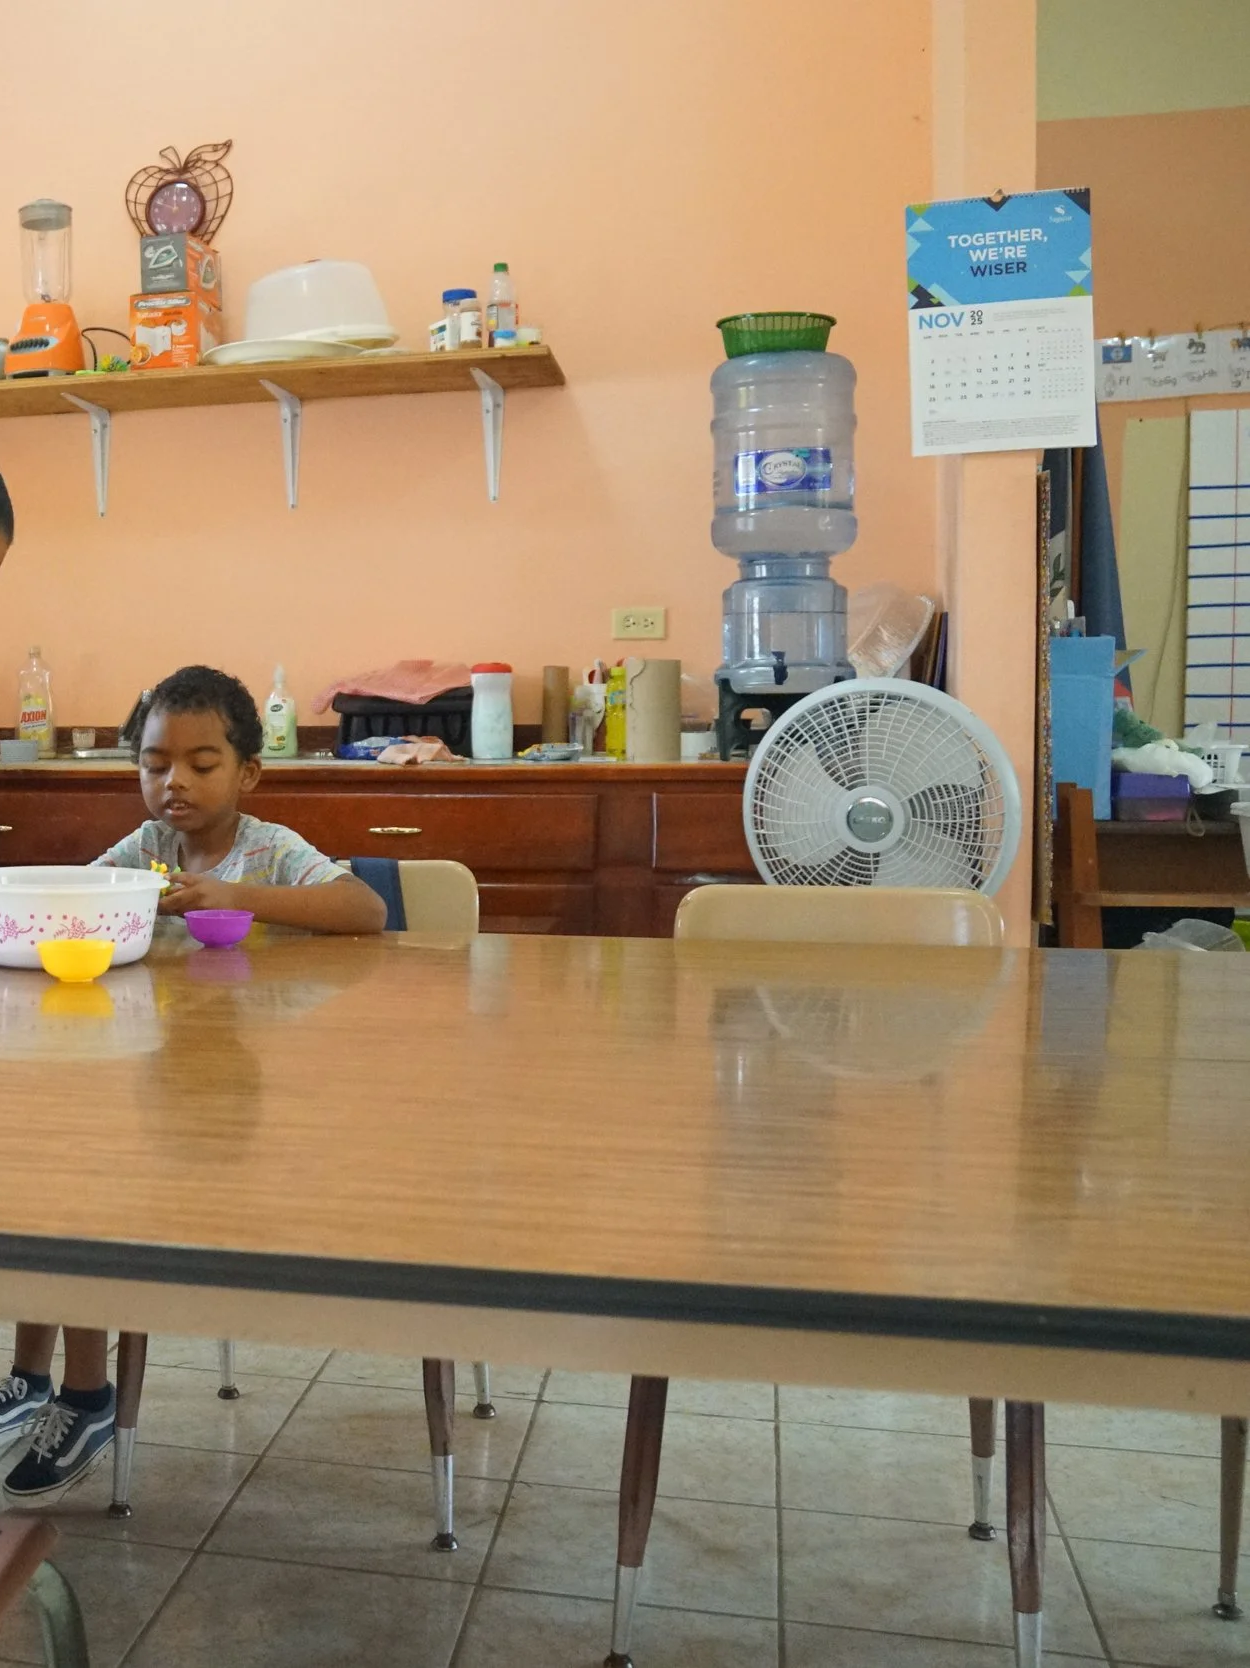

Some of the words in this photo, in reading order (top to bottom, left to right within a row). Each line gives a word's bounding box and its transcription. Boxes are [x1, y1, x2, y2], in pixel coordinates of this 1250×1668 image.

[947, 228, 1048, 248] TOGETHER,
[969, 245, 1027, 262] WE'RE
[970, 261, 1027, 278] WISER
[918, 311, 965, 330] NOV
[970, 310, 983, 318] 20
[970, 317, 983, 326] 25
[20, 709, 47, 724] AXION
